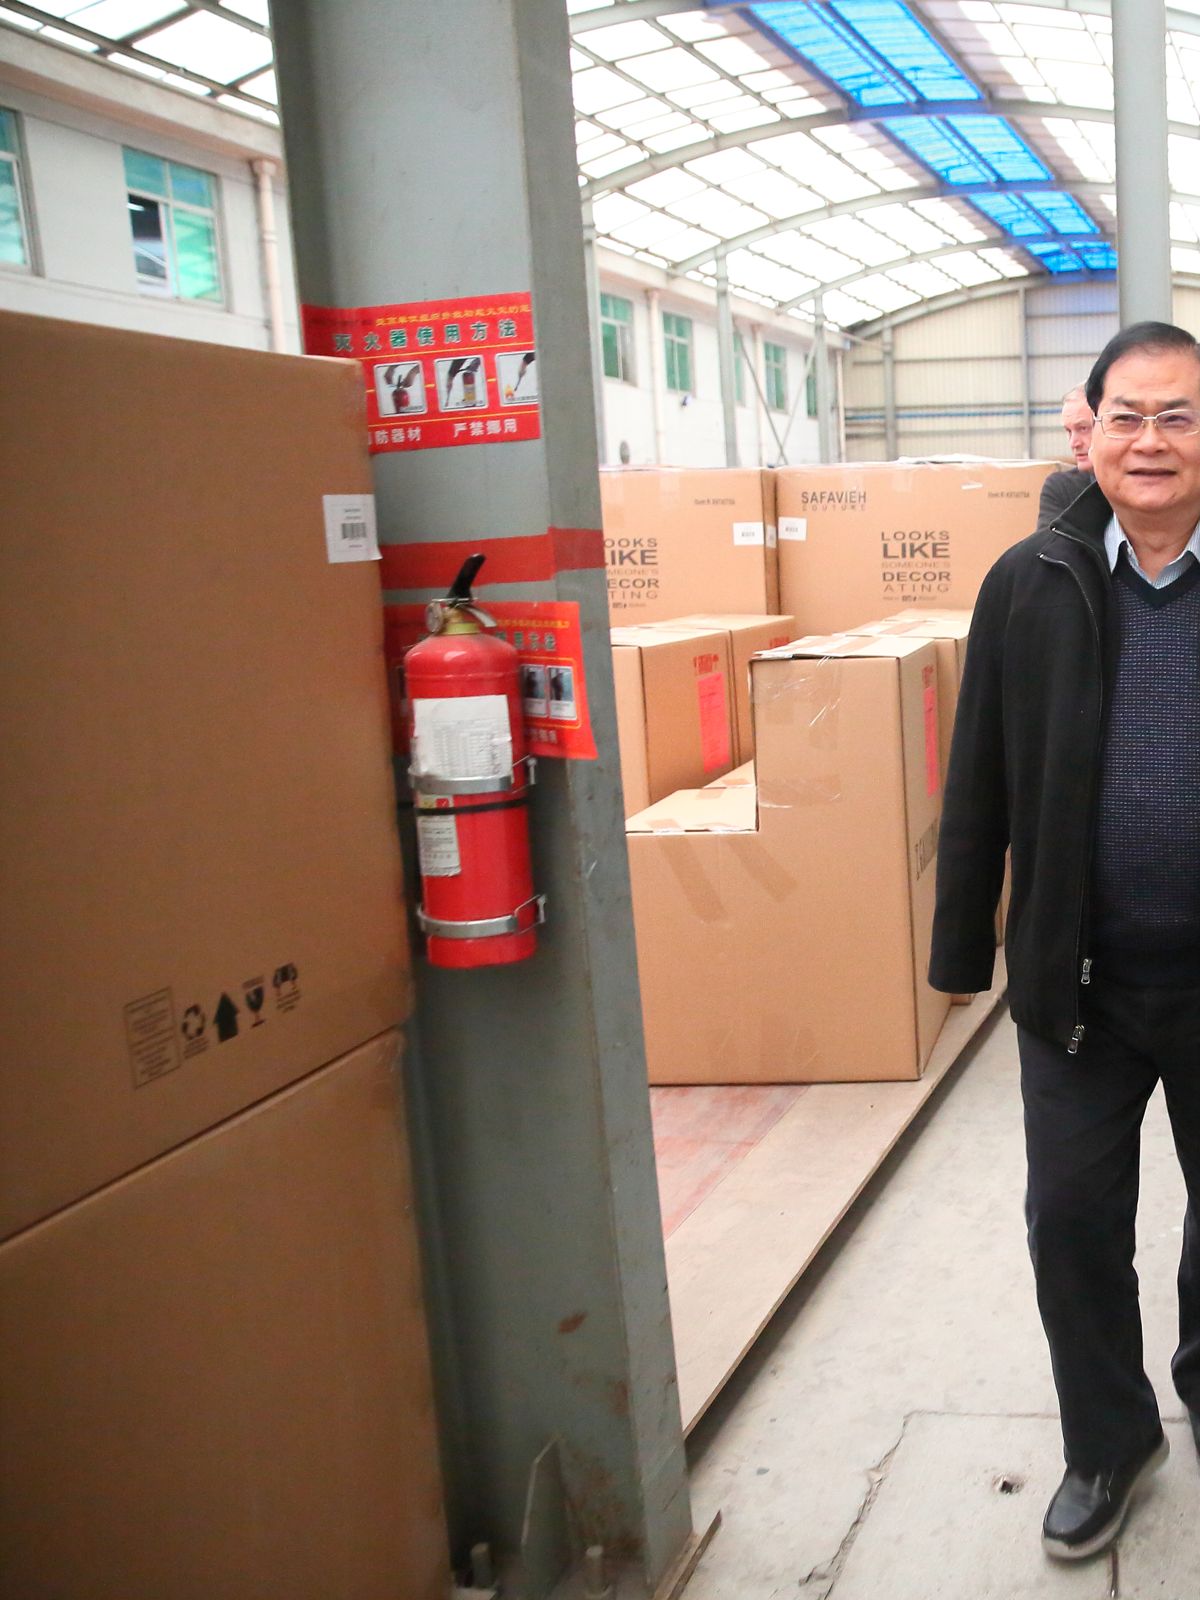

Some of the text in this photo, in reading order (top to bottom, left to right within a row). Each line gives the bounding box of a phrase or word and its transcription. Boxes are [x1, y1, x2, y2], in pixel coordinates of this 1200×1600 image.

[333, 318, 518, 353] 灭火器使用方法
[801, 491, 867, 504] SAFAVIEH
[881, 530, 950, 541] LOOKS
[604, 538, 658, 548] OOKS
[882, 542, 951, 559] LIKE
[605, 549, 659, 566] IKE
[882, 571, 951, 582] DECOR
[606, 578, 660, 589] ECOR
[883, 583, 949, 593] ATING
[609, 590, 658, 600] TING
